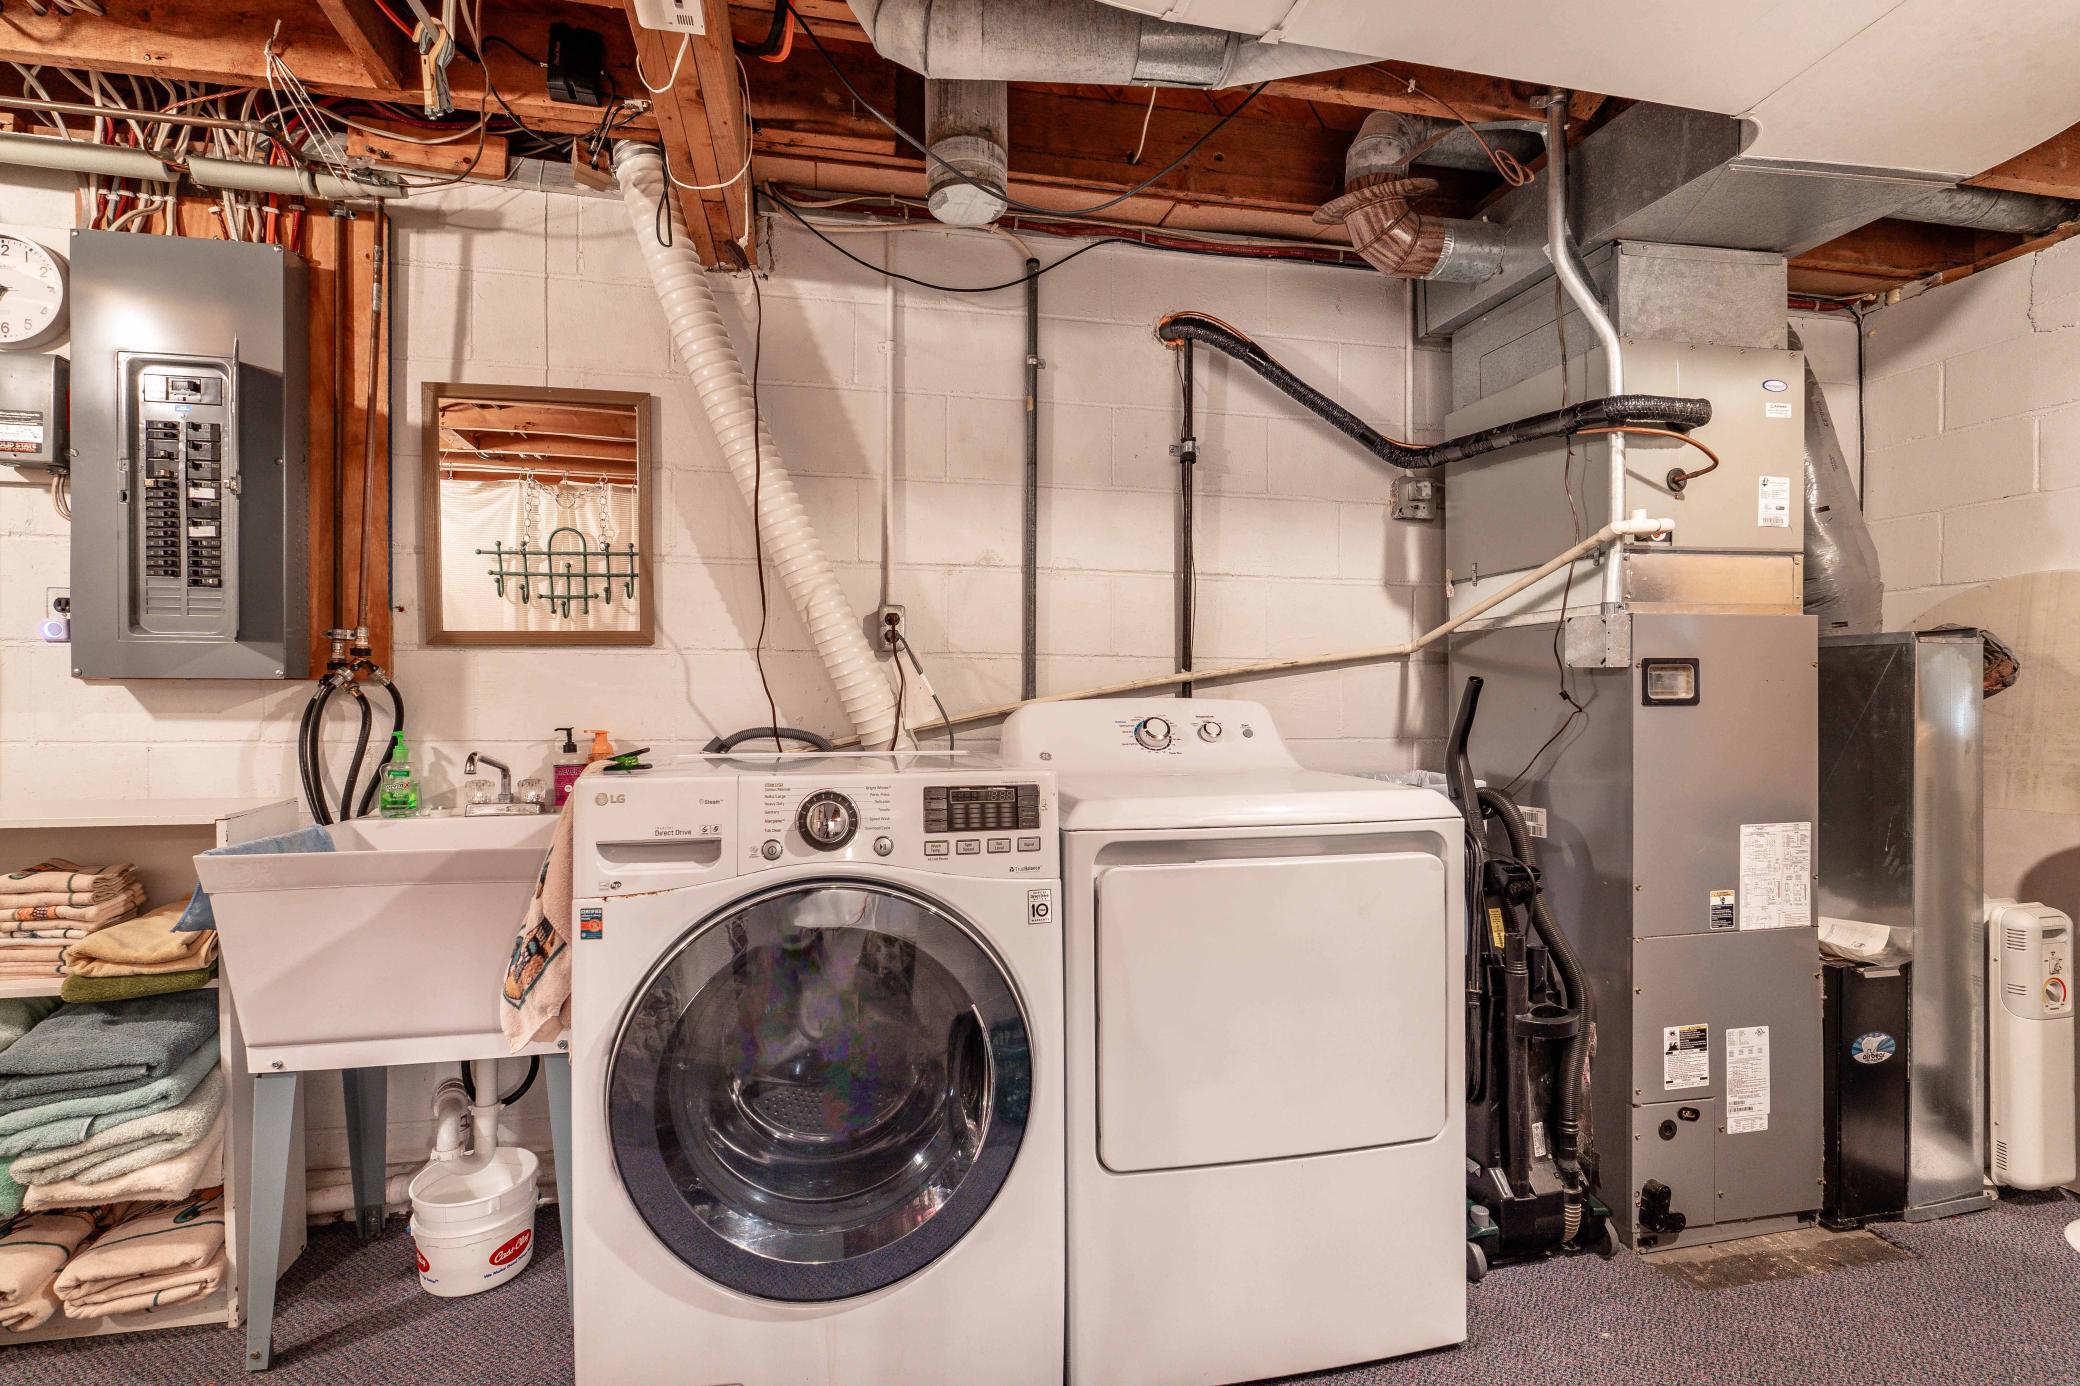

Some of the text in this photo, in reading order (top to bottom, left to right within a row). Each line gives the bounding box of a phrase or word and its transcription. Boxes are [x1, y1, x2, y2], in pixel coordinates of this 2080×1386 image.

[40, 266, 48, 278] 2
[1, 322, 10, 334] 6
[24, 319, 32, 330] 5
[610, 794, 626, 804] LG
[1031, 903, 1049, 918] 10
[494, 1231, 530, 1263] Cass-Clay
